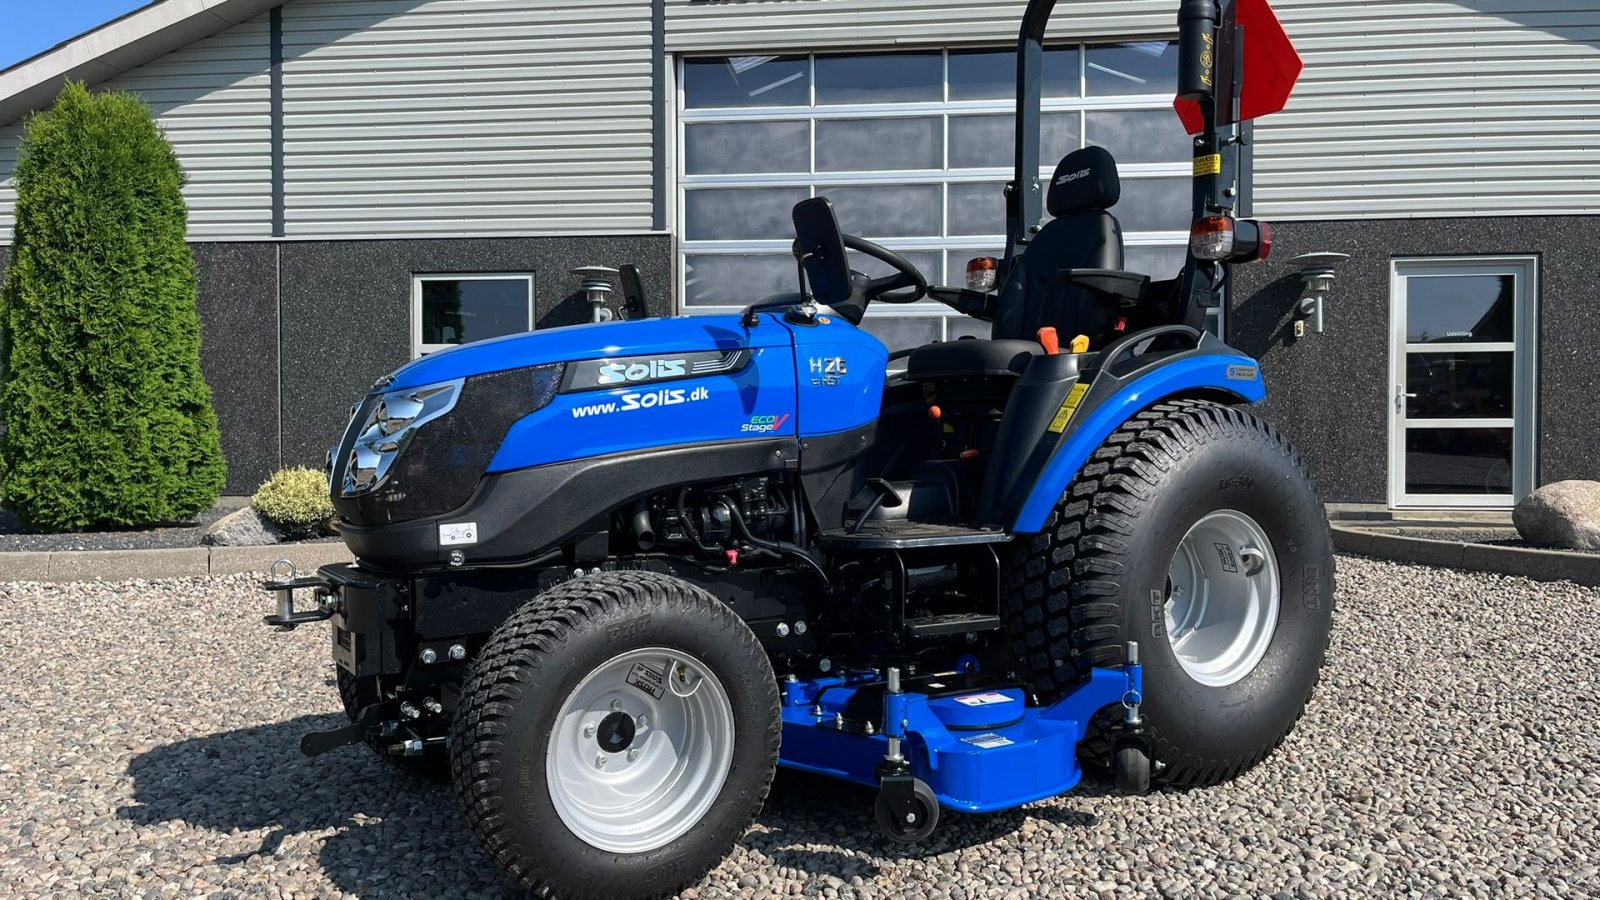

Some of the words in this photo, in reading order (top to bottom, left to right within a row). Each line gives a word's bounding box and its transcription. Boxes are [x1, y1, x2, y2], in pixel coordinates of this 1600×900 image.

[740, 423, 774, 433] Stage
[773, 413, 790, 431] V
[750, 415, 775, 424] ECO
